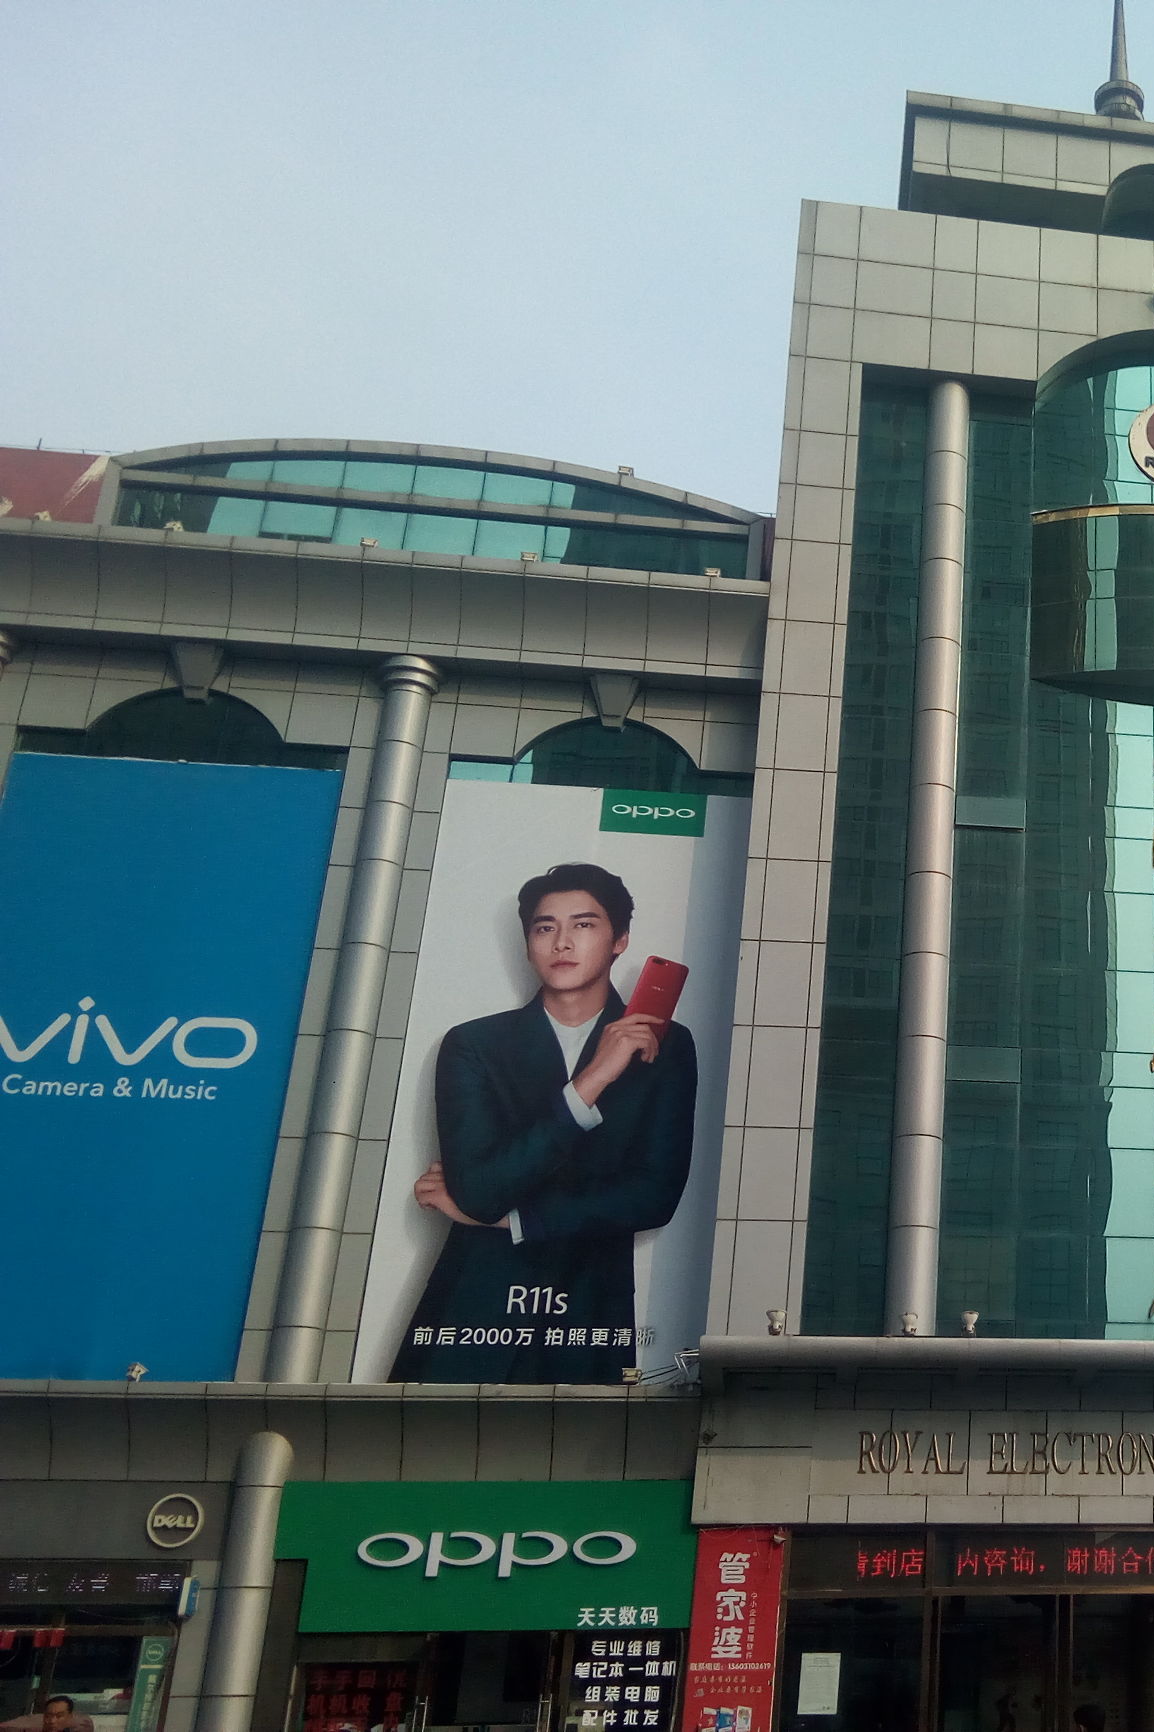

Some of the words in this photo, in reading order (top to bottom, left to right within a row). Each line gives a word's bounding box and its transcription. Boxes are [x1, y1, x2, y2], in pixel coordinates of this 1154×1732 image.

[0, 996, 258, 1069] vivo
[2, 1073, 104, 1098] Camera
[113, 1077, 132, 1098] &
[141, 1078, 218, 1100] Music
[506, 1285, 569, 1315] R11s
[413, 1326, 536, 1346] 前后2000万
[544, 1327, 656, 1348] 拍照更清晰
[857, 1431, 966, 1475] ROYAL
[153, 1513, 195, 1527] DELL
[711, 1552, 750, 1658] 管家婆
[577, 1606, 659, 1626] 天天数码
[591, 1640, 661, 1657] 专业维修
[574, 1660, 677, 1679] 笔记本一体机
[584, 1685, 660, 1703] 组装电脑
[581, 1709, 660, 1726] 配件批发
